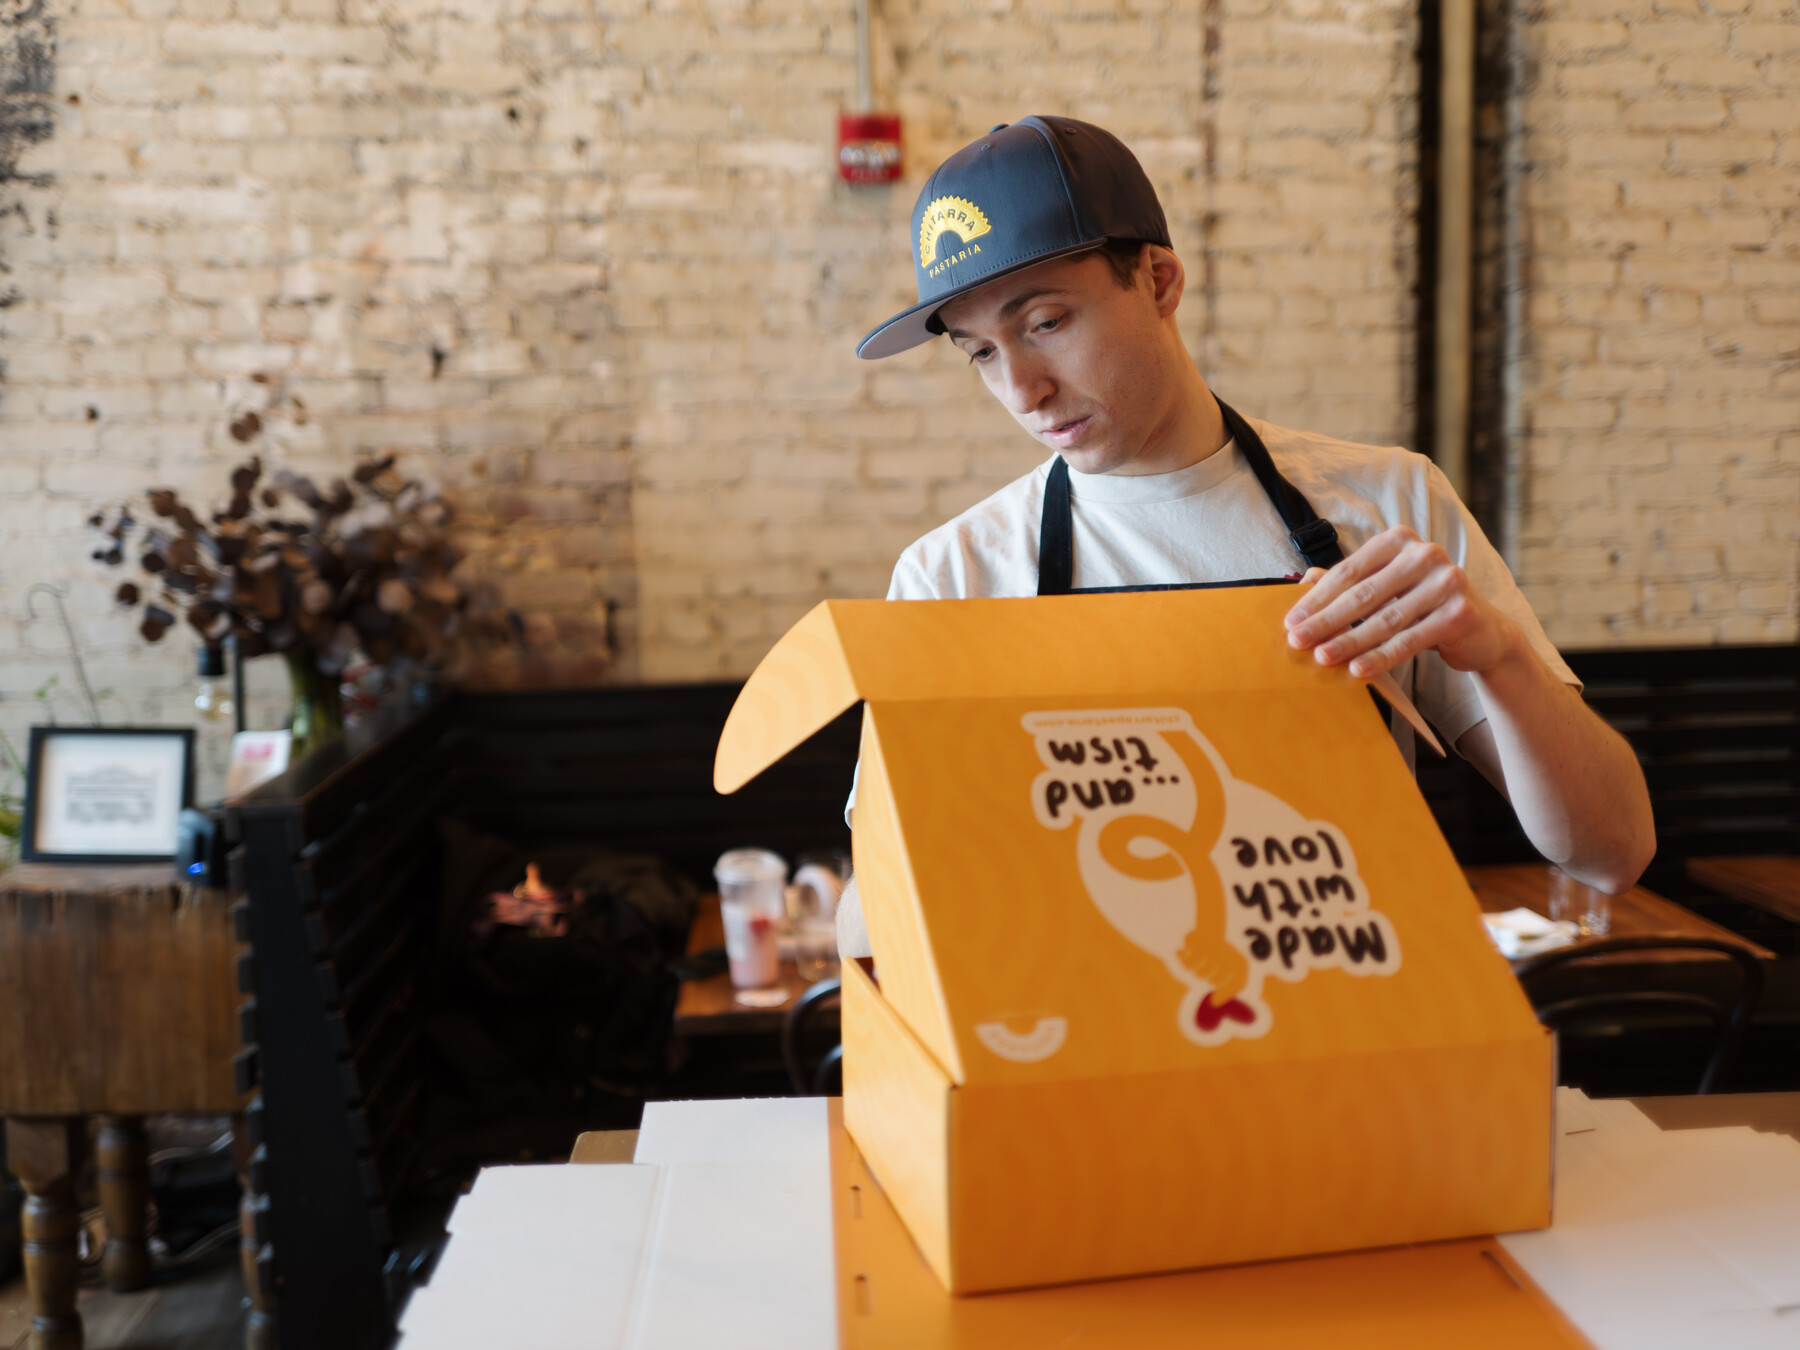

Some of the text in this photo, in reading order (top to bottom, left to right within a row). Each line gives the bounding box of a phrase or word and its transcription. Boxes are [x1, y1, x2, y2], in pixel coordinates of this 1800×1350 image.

[929, 243, 982, 279] PASTARIA
[1048, 736, 1159, 773] tism
[1230, 830, 1344, 870] love
[1232, 874, 1355, 923] with
[1244, 921, 1387, 970] Made
